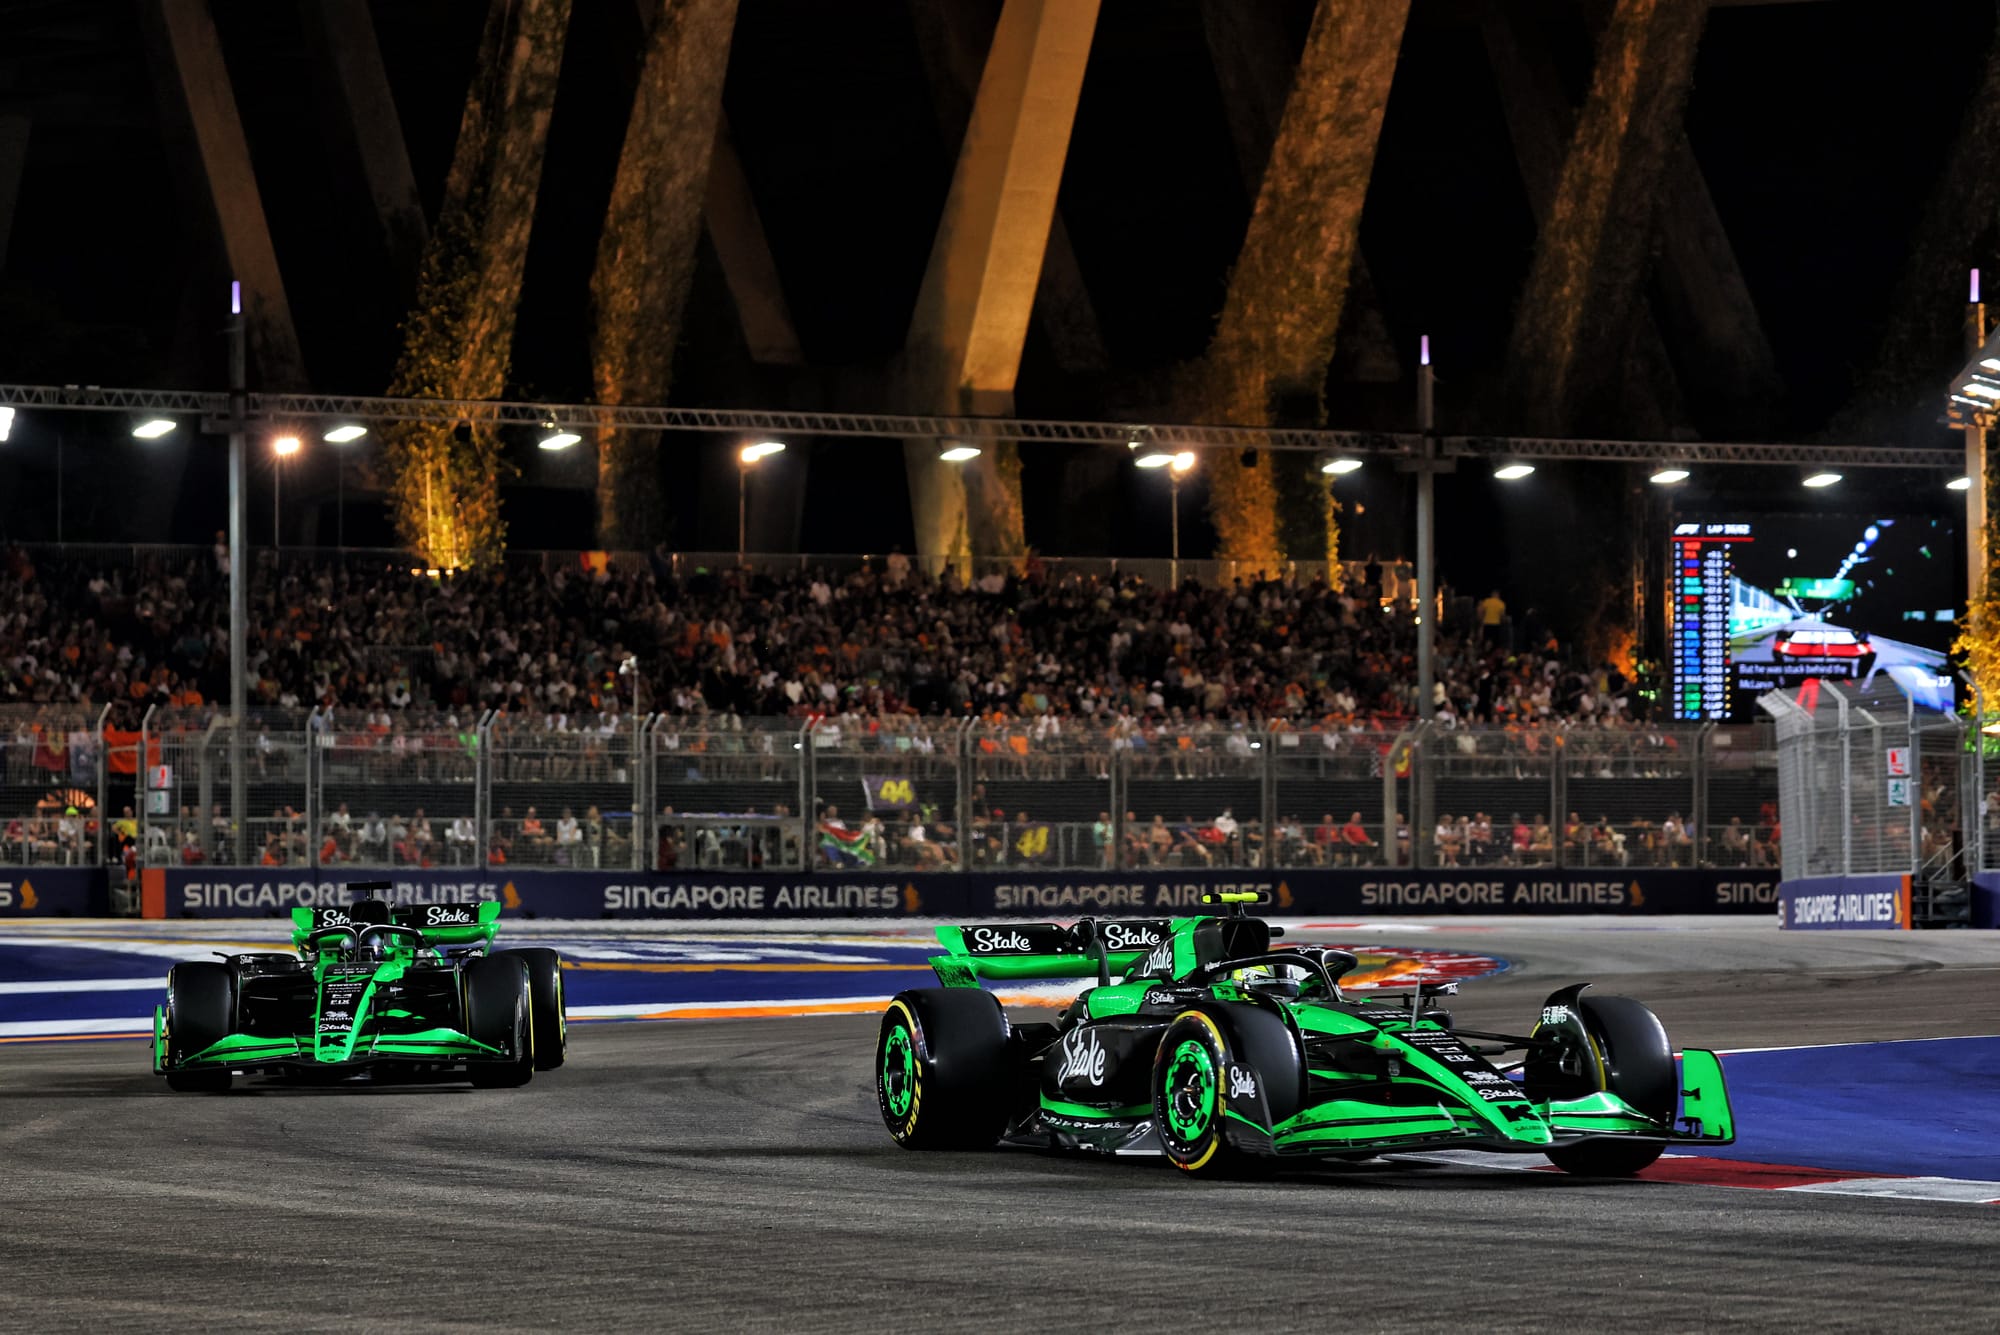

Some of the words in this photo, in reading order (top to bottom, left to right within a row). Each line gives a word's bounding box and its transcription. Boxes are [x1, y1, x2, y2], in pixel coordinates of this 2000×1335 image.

[183, 882, 353, 908] SINGAPORE
[604, 886, 765, 910] SINGAPORE
[773, 885, 899, 909] AIRLINES
[995, 884, 1145, 908] SINGAPORE
[1361, 882, 1505, 905] SINGAPORE
[1512, 882, 1624, 905] AIRLINES
[323, 909, 351, 927] Sta
[427, 906, 470, 926] Stake
[1794, 894, 1837, 924] SINGAPORE
[1837, 892, 1893, 921] AIRLINES
[974, 928, 1031, 952] Stake
[1105, 924, 1161, 950] Stake
[1142, 940, 1173, 978] Stake
[1151, 991, 1175, 1005] Stake
[1378, 1020, 1442, 1033] 24
[1058, 1025, 1105, 1088] Stake
[1230, 1066, 1256, 1098] Stake
[906, 1080, 922, 1136] ZERO
